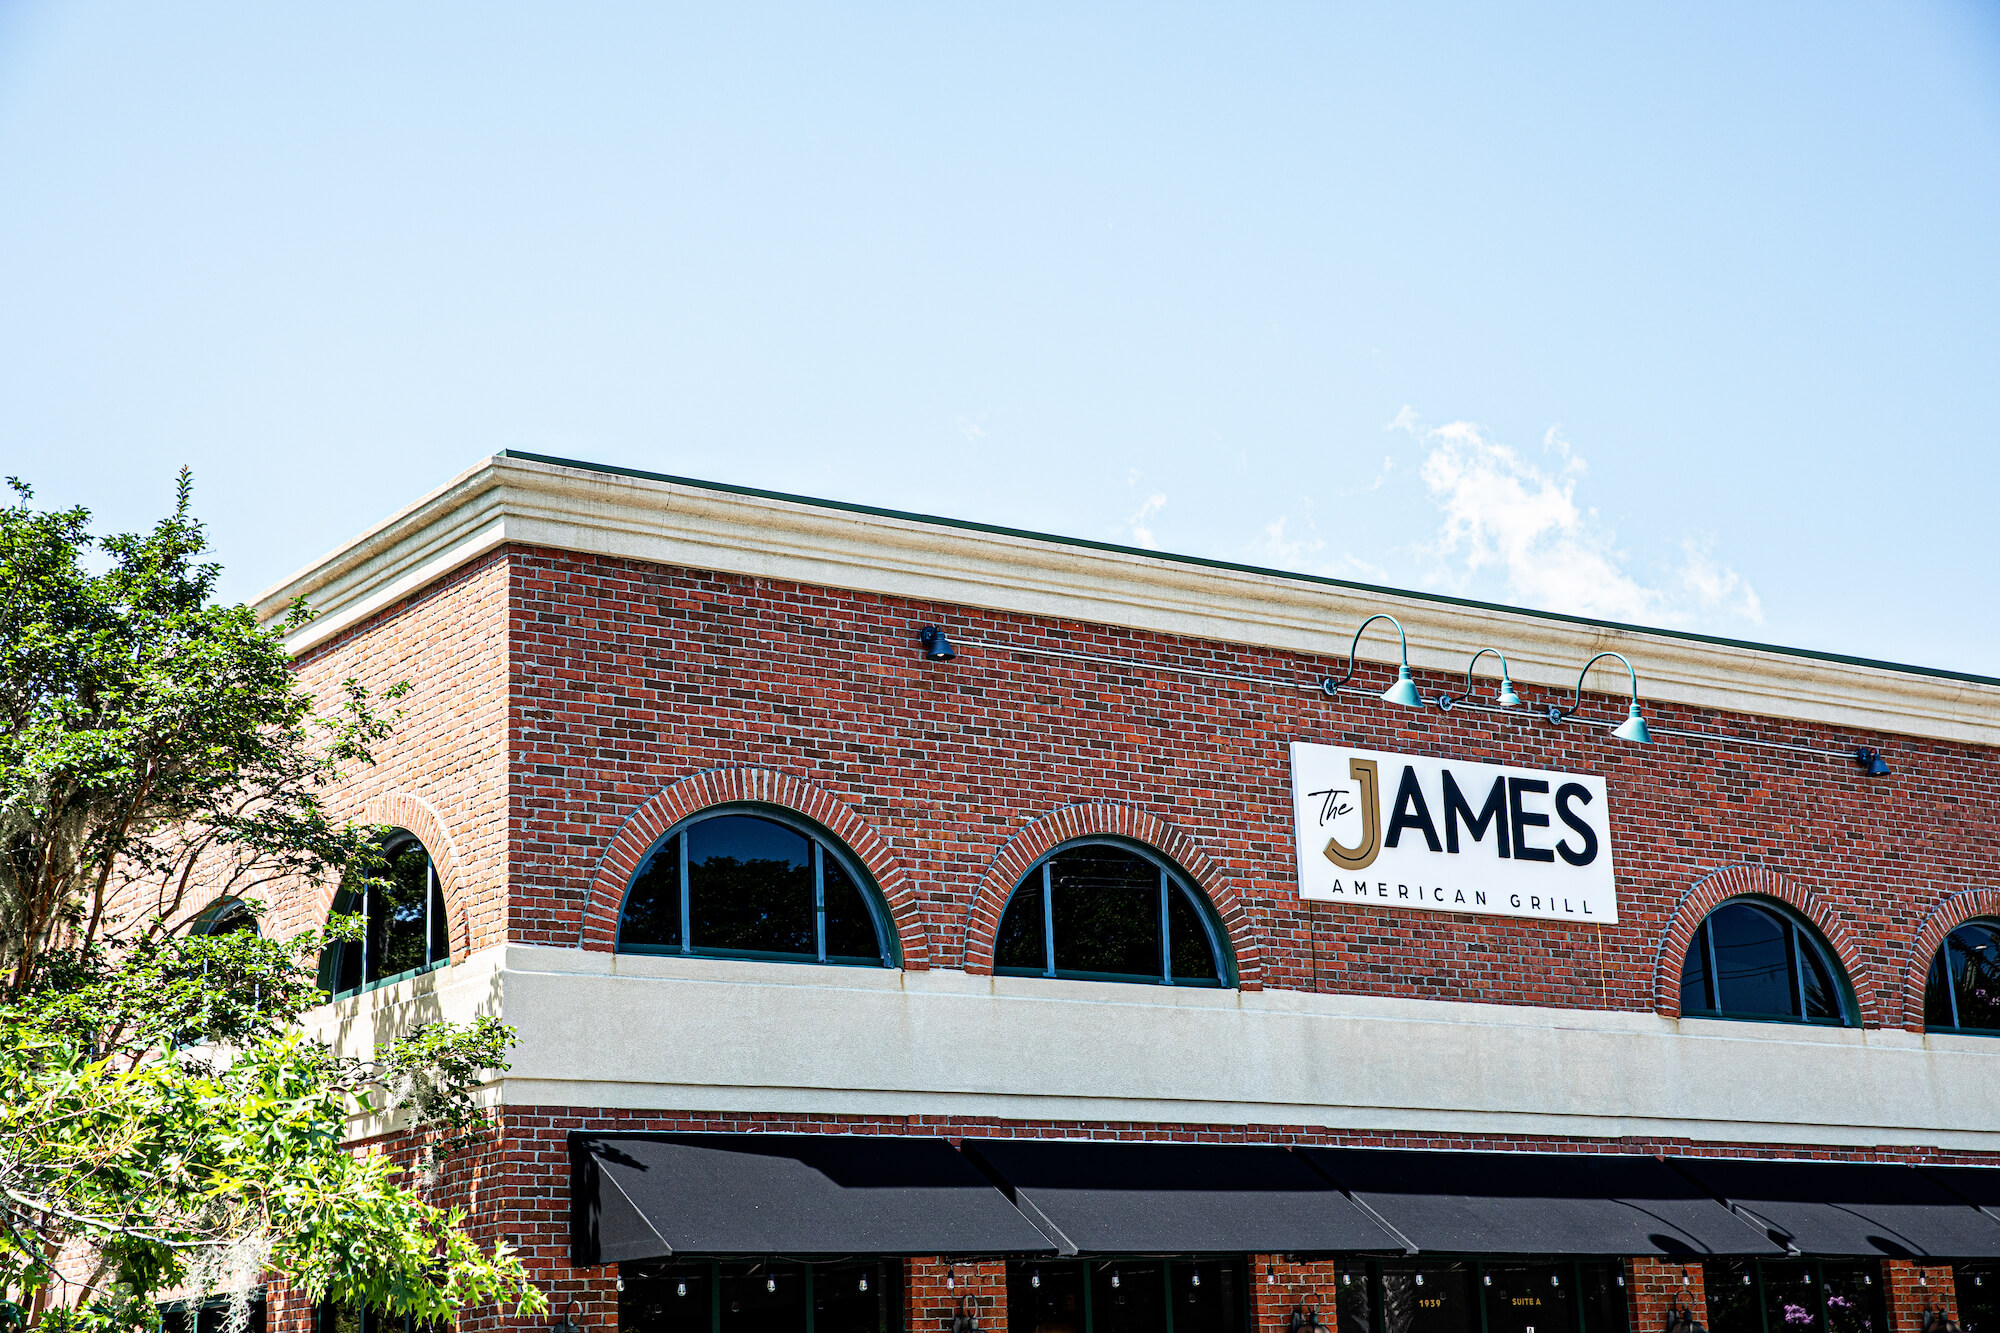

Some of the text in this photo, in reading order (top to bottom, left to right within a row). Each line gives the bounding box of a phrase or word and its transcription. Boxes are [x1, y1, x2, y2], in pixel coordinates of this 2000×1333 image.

[1308, 758, 1598, 870] The JAMES
[1332, 879, 1593, 914] AMERICAN GRILL
[1419, 1299, 1441, 1307] 1939
[1512, 1298, 1541, 1306] SUITE A
